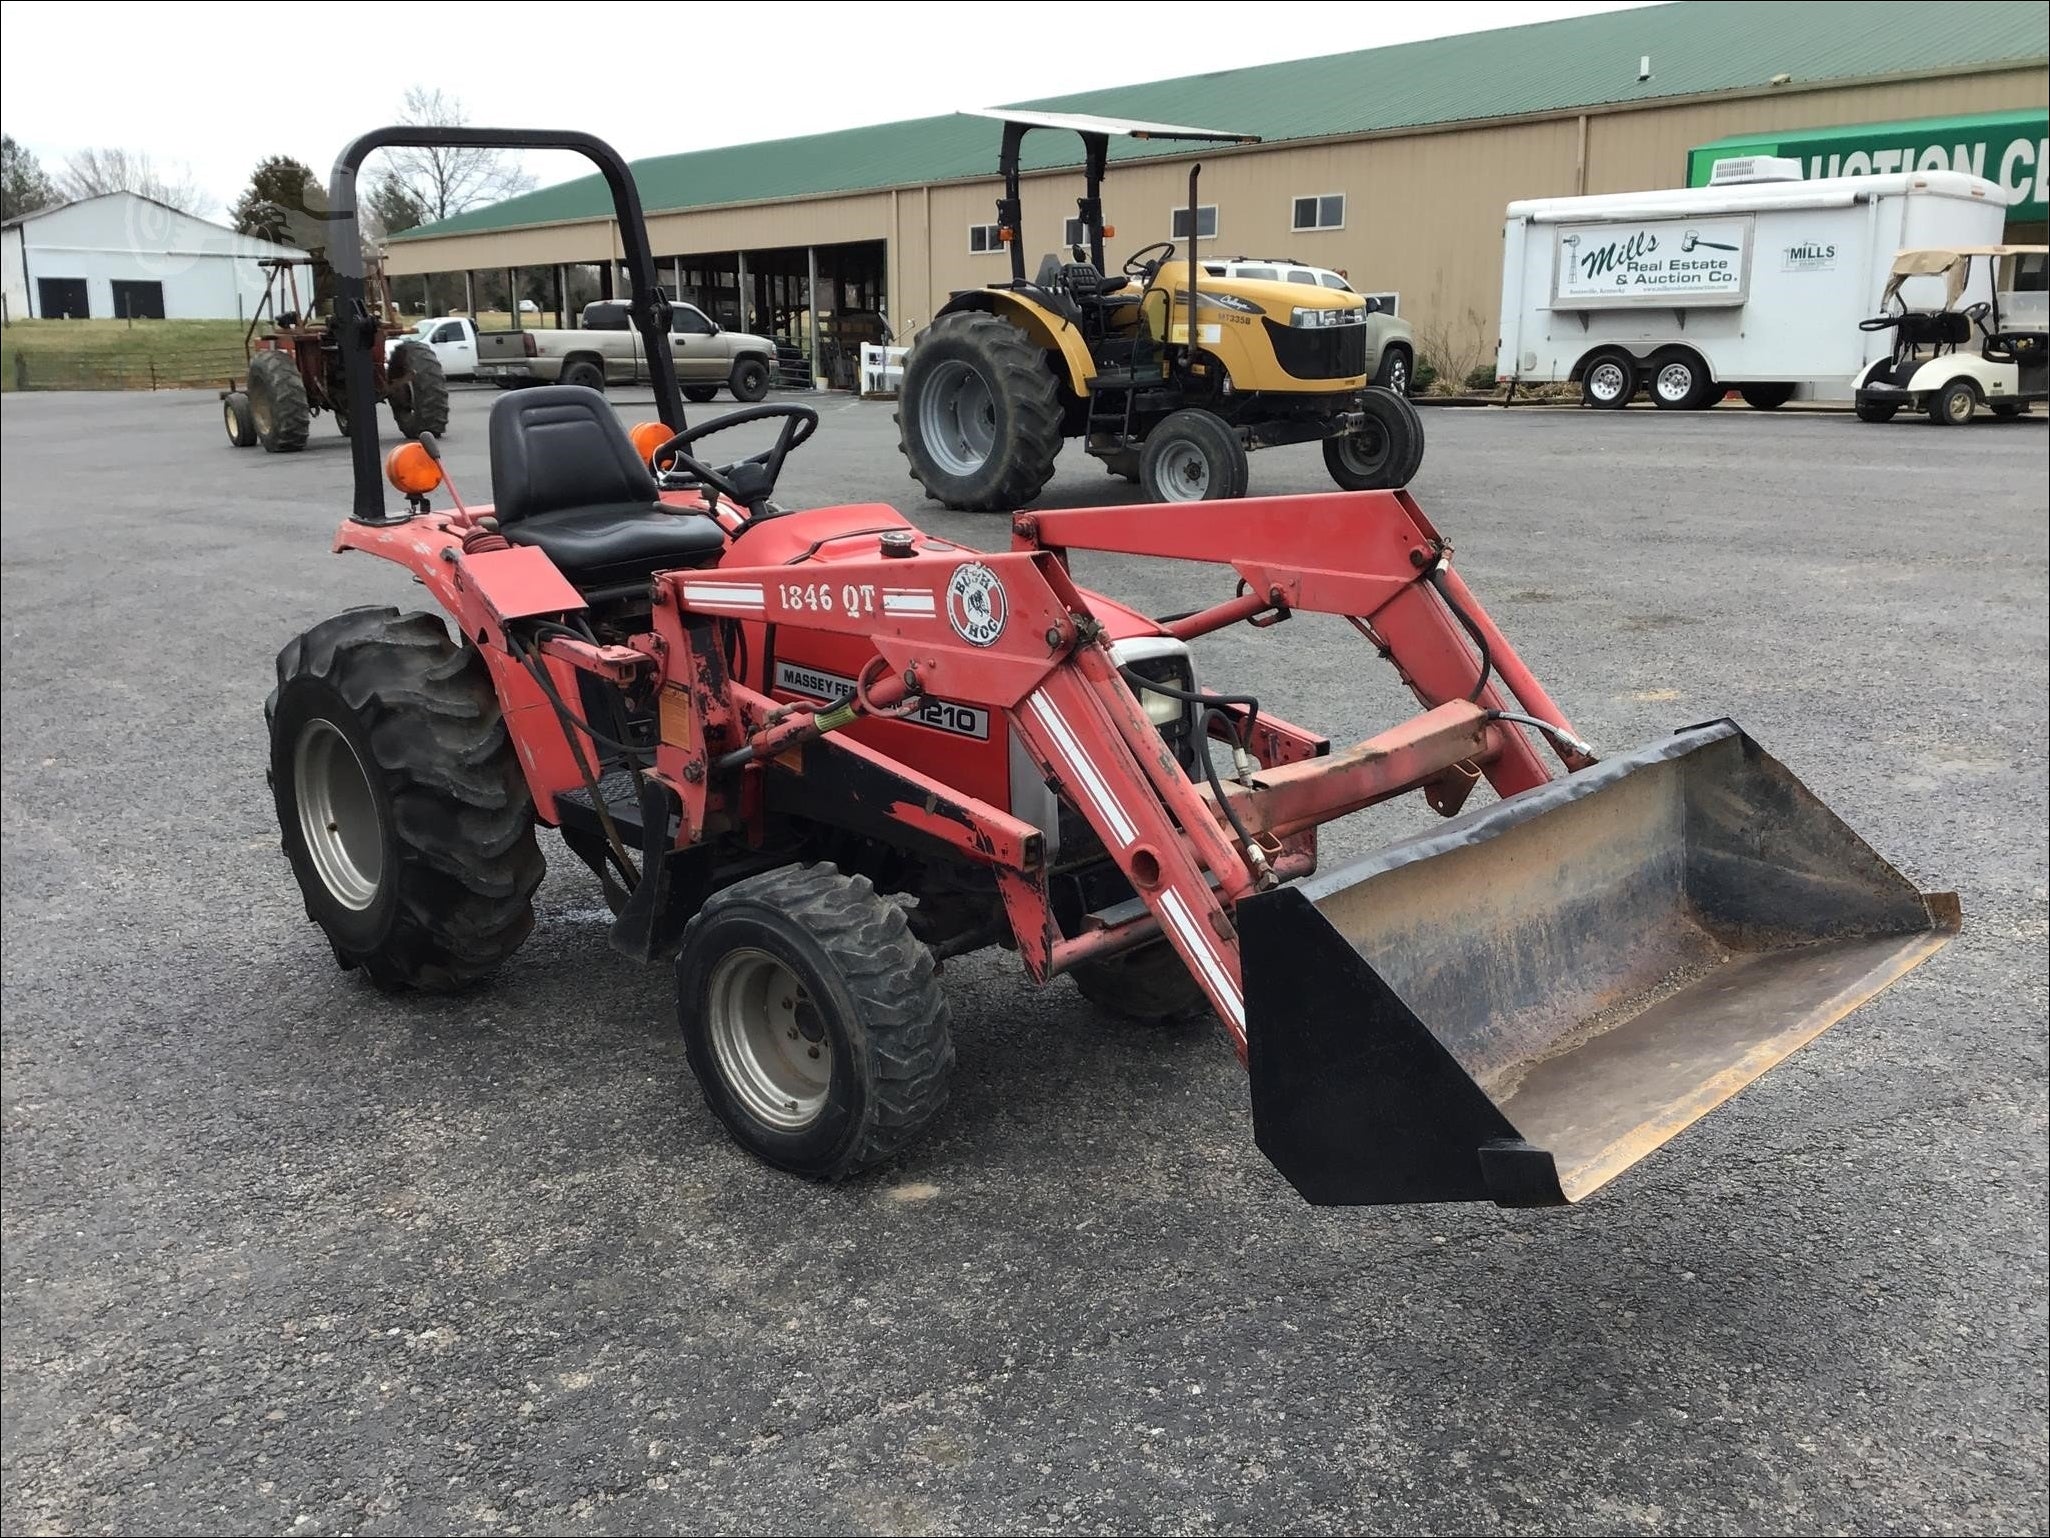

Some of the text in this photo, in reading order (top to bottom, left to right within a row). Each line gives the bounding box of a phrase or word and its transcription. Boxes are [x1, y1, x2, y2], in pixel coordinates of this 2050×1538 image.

[1581, 231, 1660, 279] Mills
[1790, 246, 1835, 259] MILLS
[1627, 259, 1728, 272] Real Estate
[1616, 271, 1738, 285] & Auction Co.
[779, 584, 875, 618] 1846 QT
[968, 619, 998, 639] HOG
[784, 669, 833, 693] MASSEY
[920, 703, 976, 731] 1210
